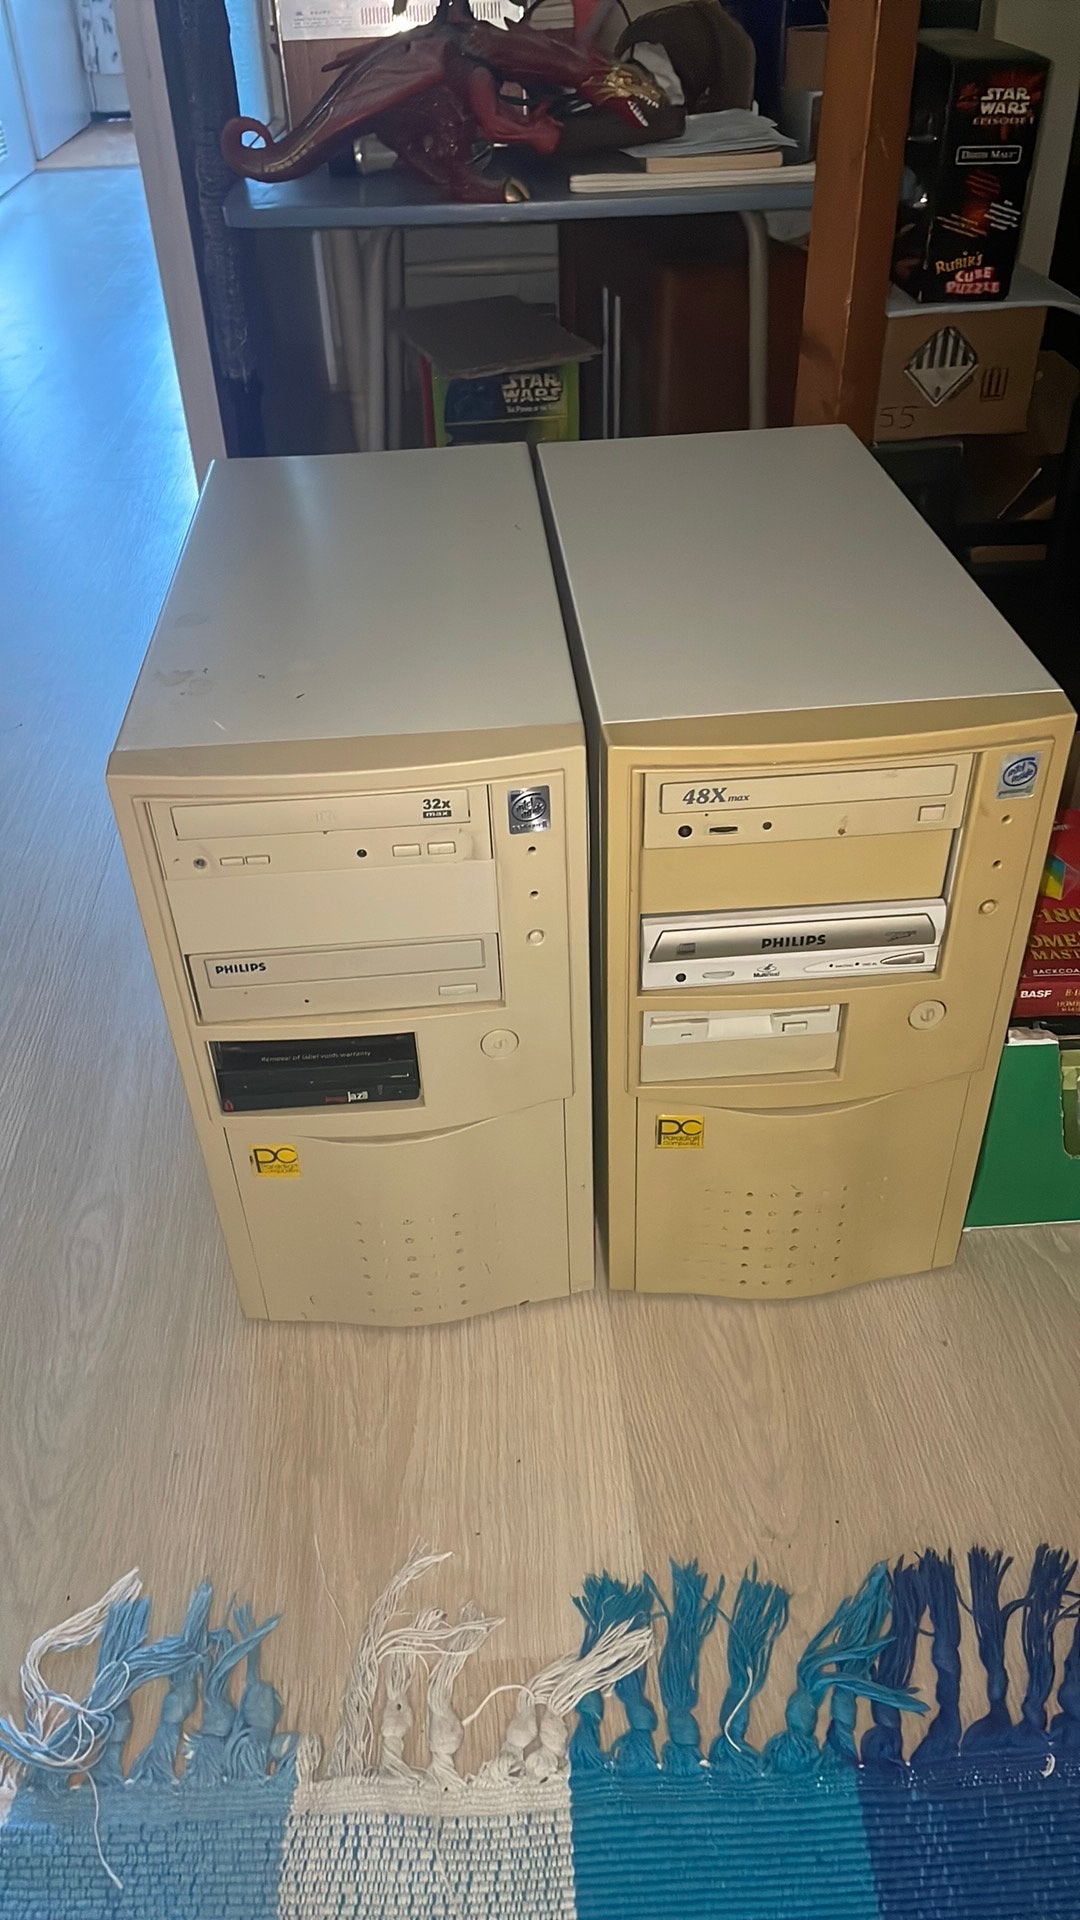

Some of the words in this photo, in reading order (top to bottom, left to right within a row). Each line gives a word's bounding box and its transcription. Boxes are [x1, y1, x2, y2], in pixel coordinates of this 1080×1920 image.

[980, 87, 1031, 100] STAR
[980, 102, 1031, 114] WARS
[955, 266, 994, 282] CUBE
[945, 281, 1001, 295] PUZZLE
[501, 373, 562, 389] STAR
[502, 387, 563, 403] WARS
[879, 406, 924, 429] 55
[682, 787, 727, 805] 48X
[727, 794, 750, 802] max
[422, 798, 451, 810] 32x
[761, 934, 826, 949] PHILIPS
[215, 963, 266, 974] PHILIPS
[1020, 989, 1053, 998] BASF
